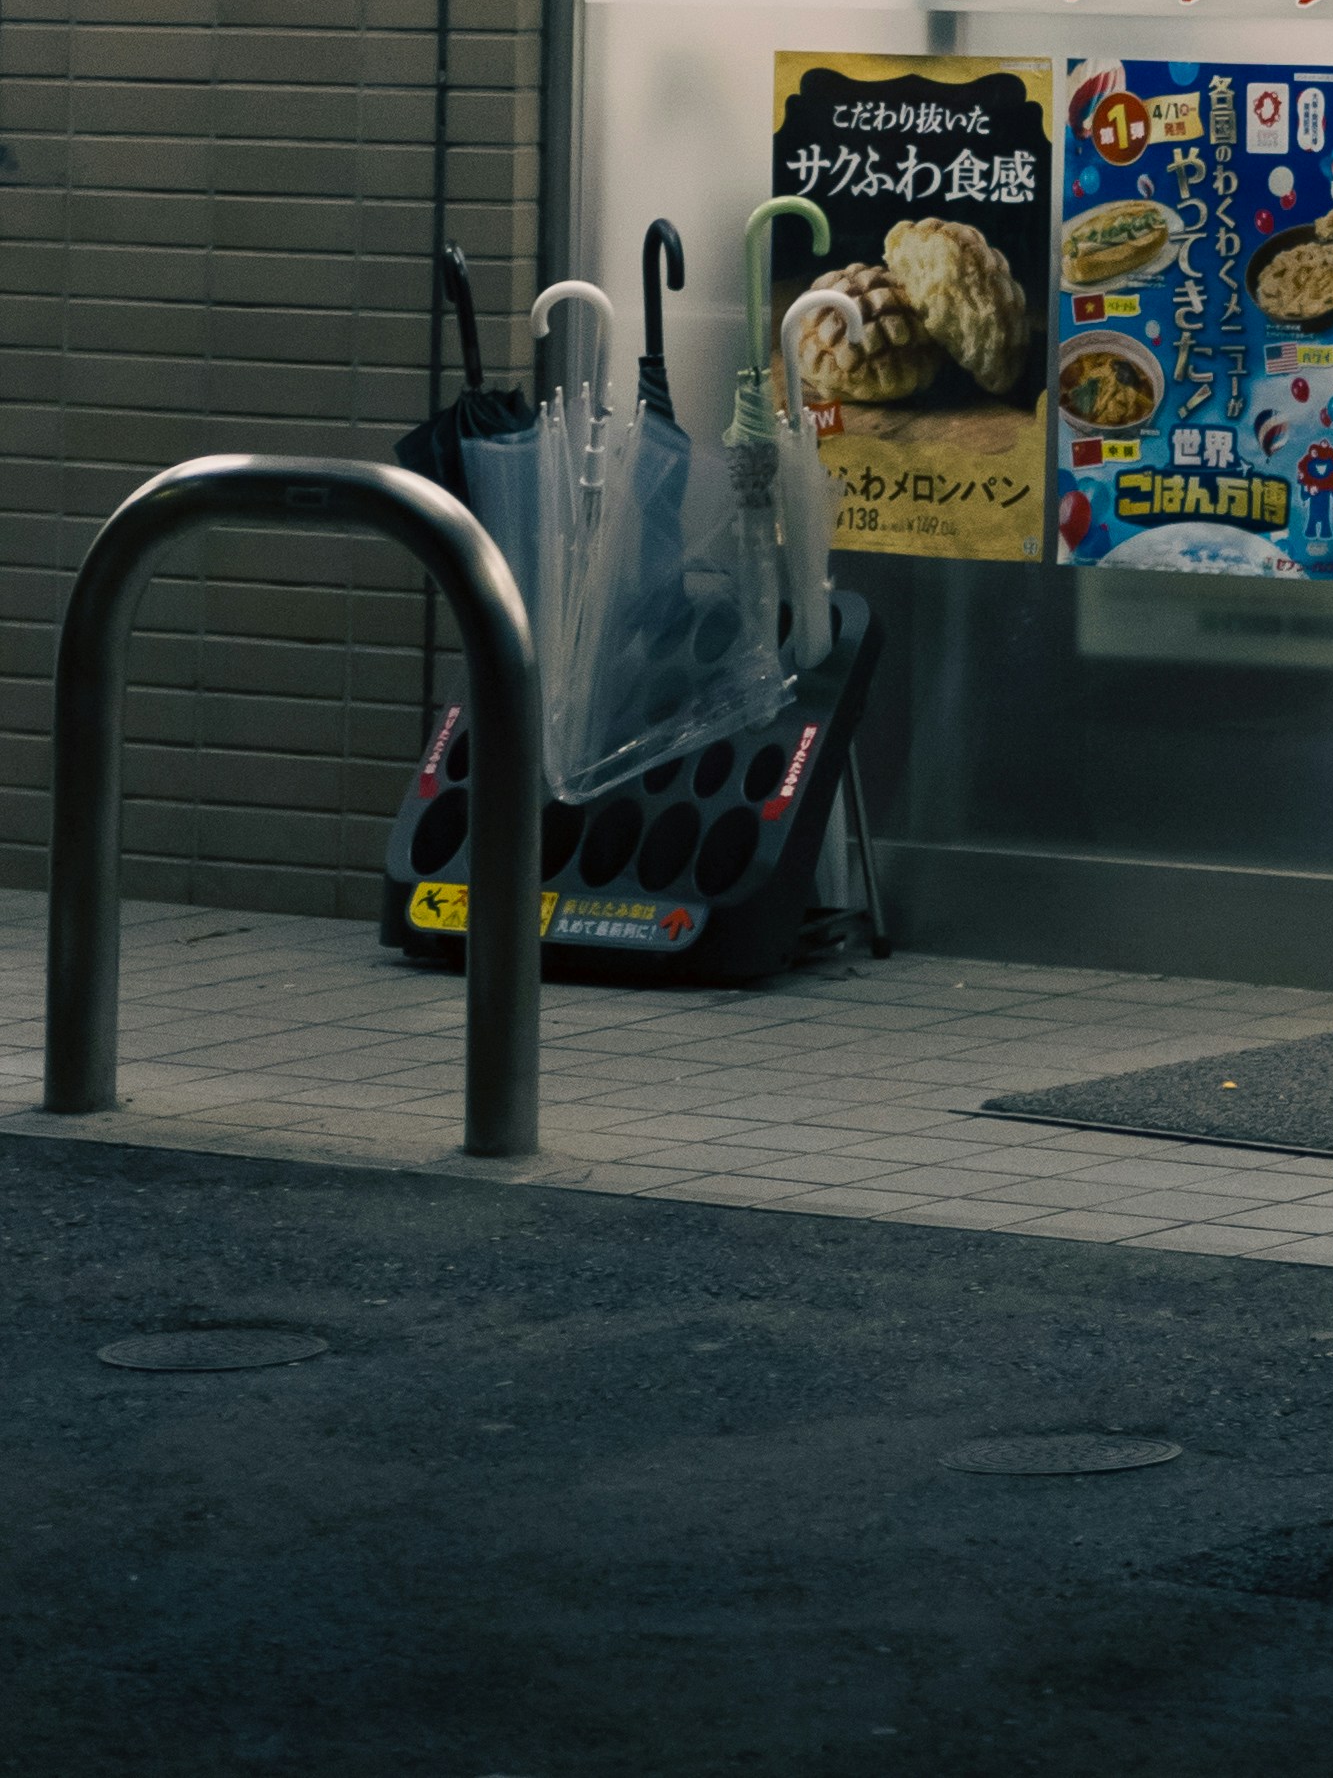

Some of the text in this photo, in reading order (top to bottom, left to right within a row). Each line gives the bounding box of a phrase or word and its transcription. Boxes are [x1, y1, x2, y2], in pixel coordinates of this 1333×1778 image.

[832, 101, 991, 135] こだわり抜いた
[786, 143, 1037, 204] サクふわ食感
[1208, 74, 1248, 420] 各国のわくわくメニューが
[1172, 428, 1235, 469] 世界
[1117, 469, 1288, 527] ごはん万博
